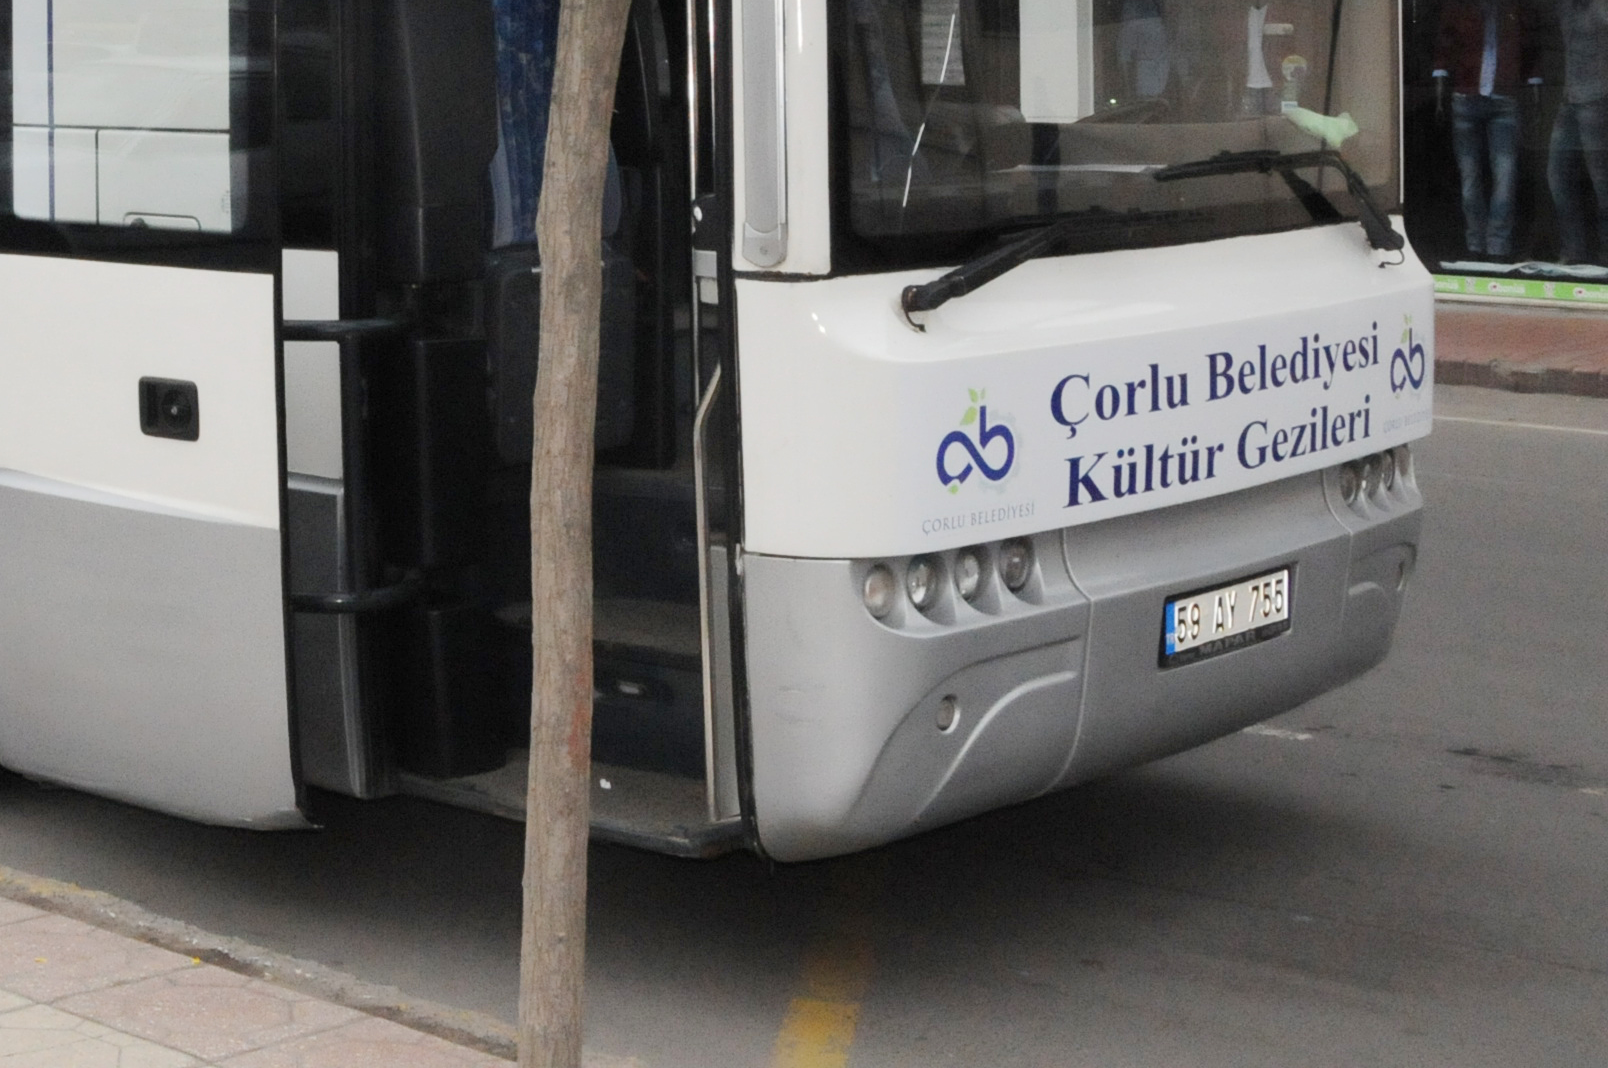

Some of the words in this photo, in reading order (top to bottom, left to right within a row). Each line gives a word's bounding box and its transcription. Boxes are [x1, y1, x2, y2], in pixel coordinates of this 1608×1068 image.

[1050, 363, 1190, 440] Çorlu
[1204, 320, 1380, 402] Belediyesi
[1062, 434, 1225, 509] Kültür
[1236, 393, 1371, 470] Gezileri
[921, 514, 966, 537] ÇORLU
[970, 500, 1035, 527] BELEDİYESİ
[1175, 602, 1201, 644] 59
[1213, 590, 1237, 634] AY
[1248, 578, 1284, 623] 755
